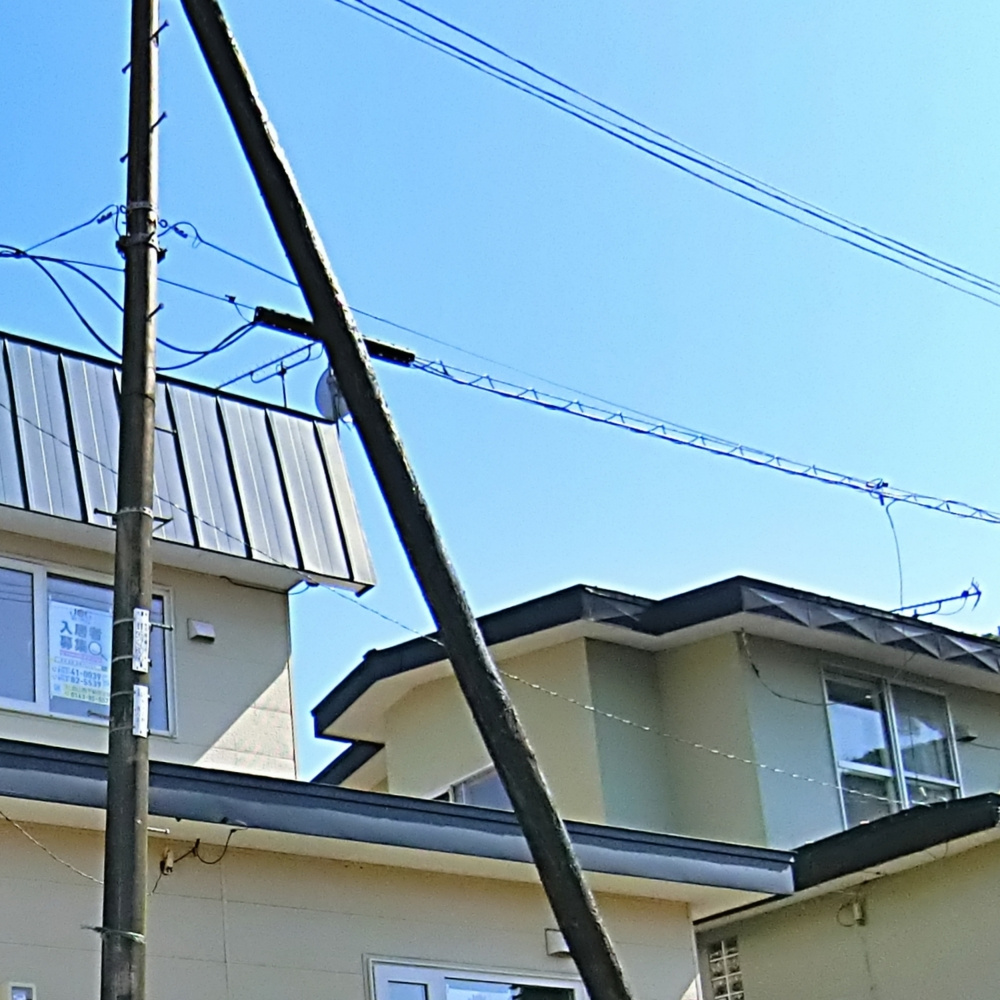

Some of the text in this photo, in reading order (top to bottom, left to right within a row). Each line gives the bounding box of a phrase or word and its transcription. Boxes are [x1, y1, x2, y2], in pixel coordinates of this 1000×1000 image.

[60, 620, 102, 641] 入居者
[60, 635, 88, 653] 募集
